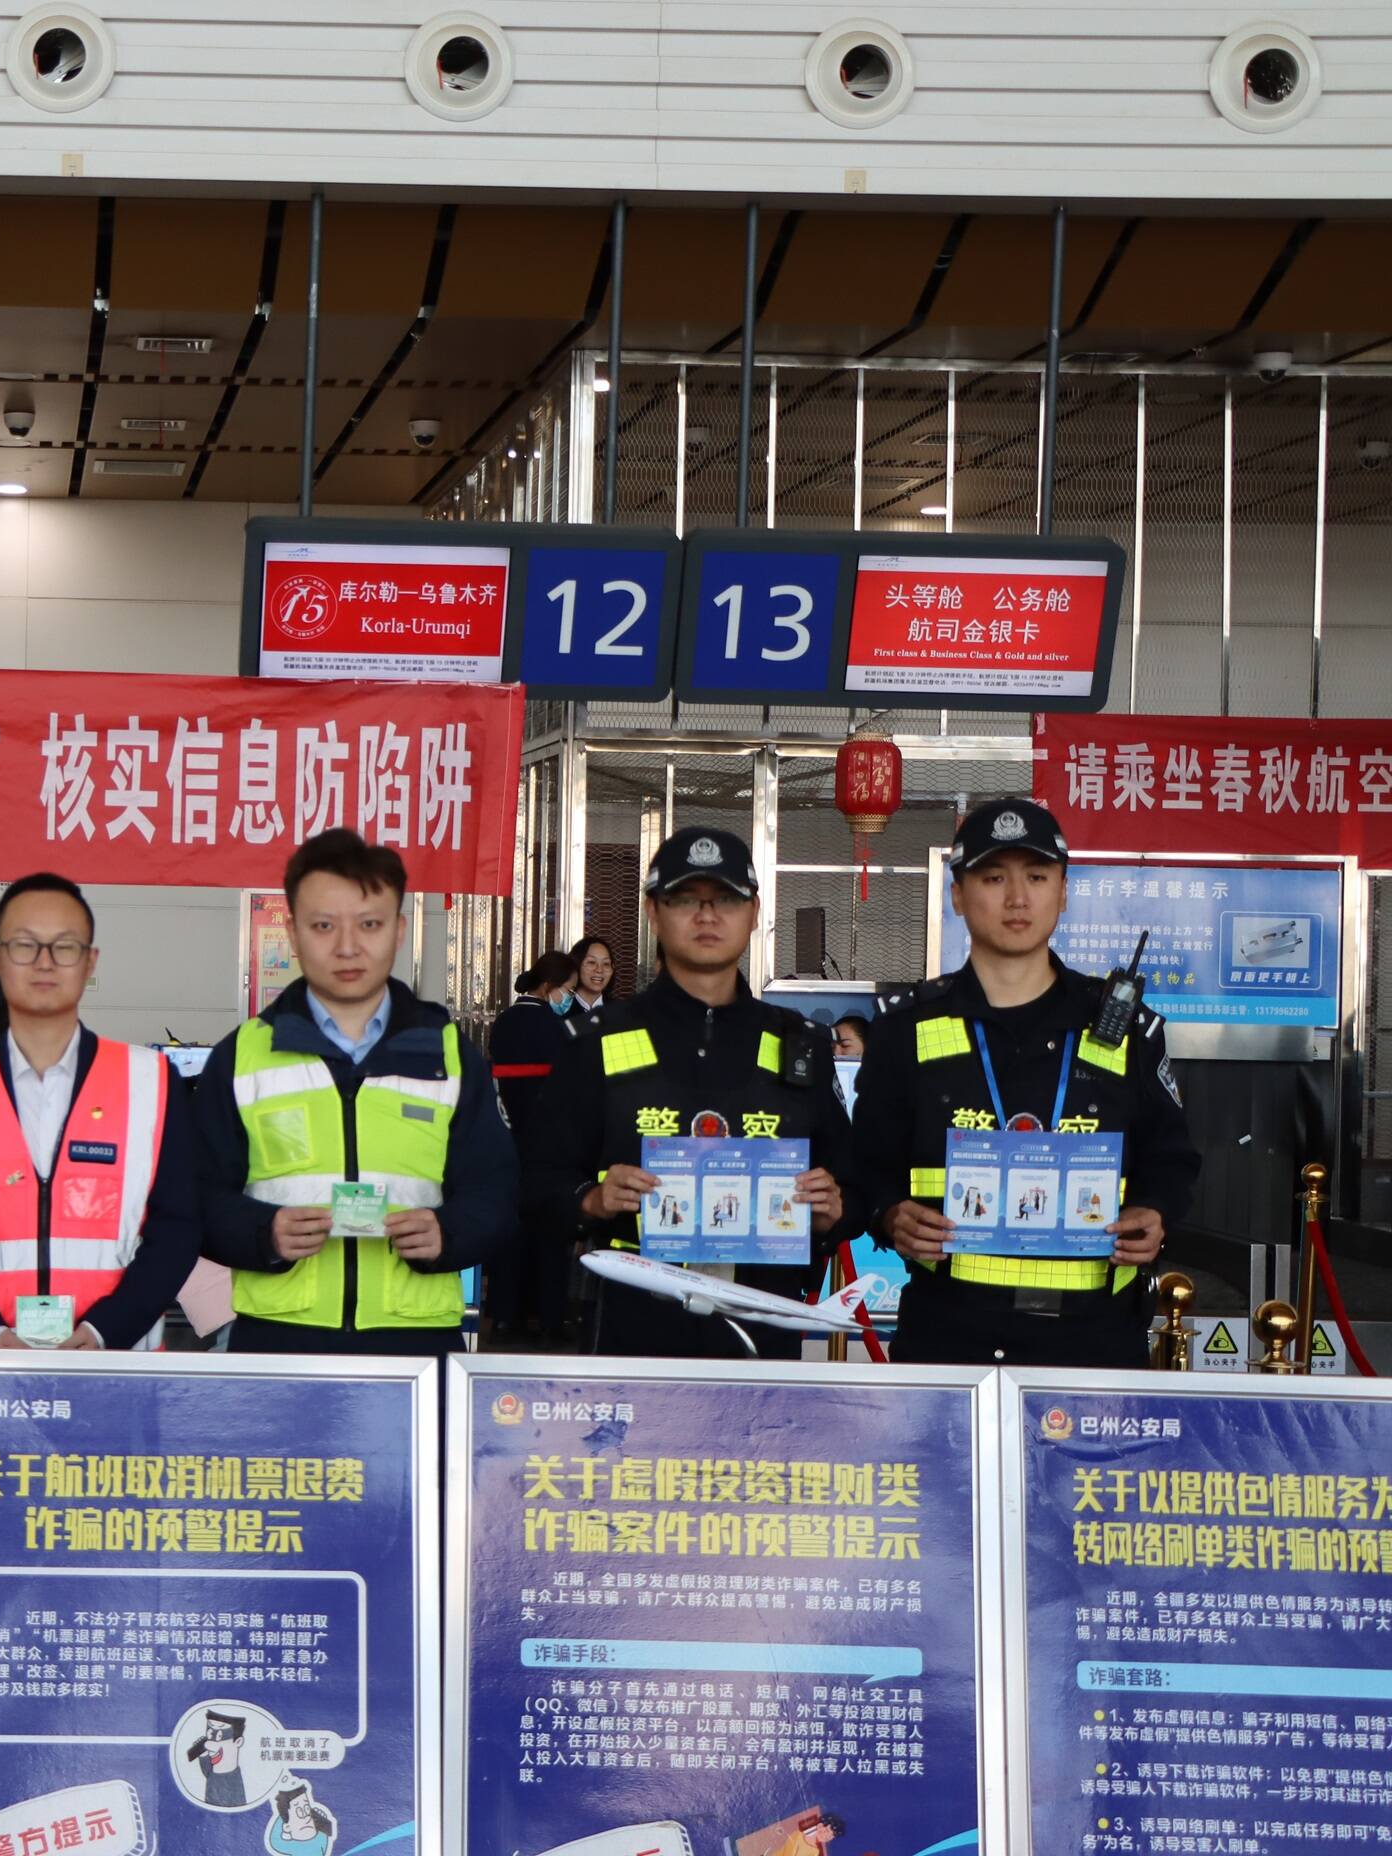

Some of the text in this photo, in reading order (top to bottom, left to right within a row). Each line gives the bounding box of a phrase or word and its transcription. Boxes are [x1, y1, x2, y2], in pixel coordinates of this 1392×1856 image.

[339, 581, 497, 606] 库尔勒—乌鲁木齐
[885, 584, 1071, 613] 头等舱 公务舱
[360, 617, 471, 639] Korla-Urumqi
[546, 579, 646, 657] 12
[713, 584, 814, 661] 13
[907, 617, 1040, 644] 航司金银卡
[873, 648, 1070, 662] First class & Business Class & Gold and silver
[40, 712, 472, 851] 核实信息防陷阱
[1064, 742, 1392, 814] 请乘坐春秋航空
[1066, 879, 1230, 900] 运行李温馨提示
[1229, 971, 1311, 984] 侧面把手朝上
[635, 1107, 782, 1139] 警 察
[531, 1401, 635, 1423] 巴州公安局
[1080, 1416, 1182, 1439] 巴州公安局
[524, 1456, 921, 1508] 关于虚假投资理财类
[1072, 1467, 1392, 1520] 关于以提供色情服务为
[24, 1506, 303, 1554] 诈骗的预警提示
[523, 1508, 921, 1560] 诈骗案件的预警提示
[521, 1606, 546, 1621] 失。
[1076, 1624, 1238, 1645] 惕，避免造成财产损失。
[534, 1644, 616, 1664] 诈骗手段：
[1089, 1666, 1171, 1687] 诈骗套路：
[259, 1736, 331, 1749] 航班取消了
[259, 1750, 331, 1763] 机票需要退费
[519, 1768, 544, 1784] 联。
